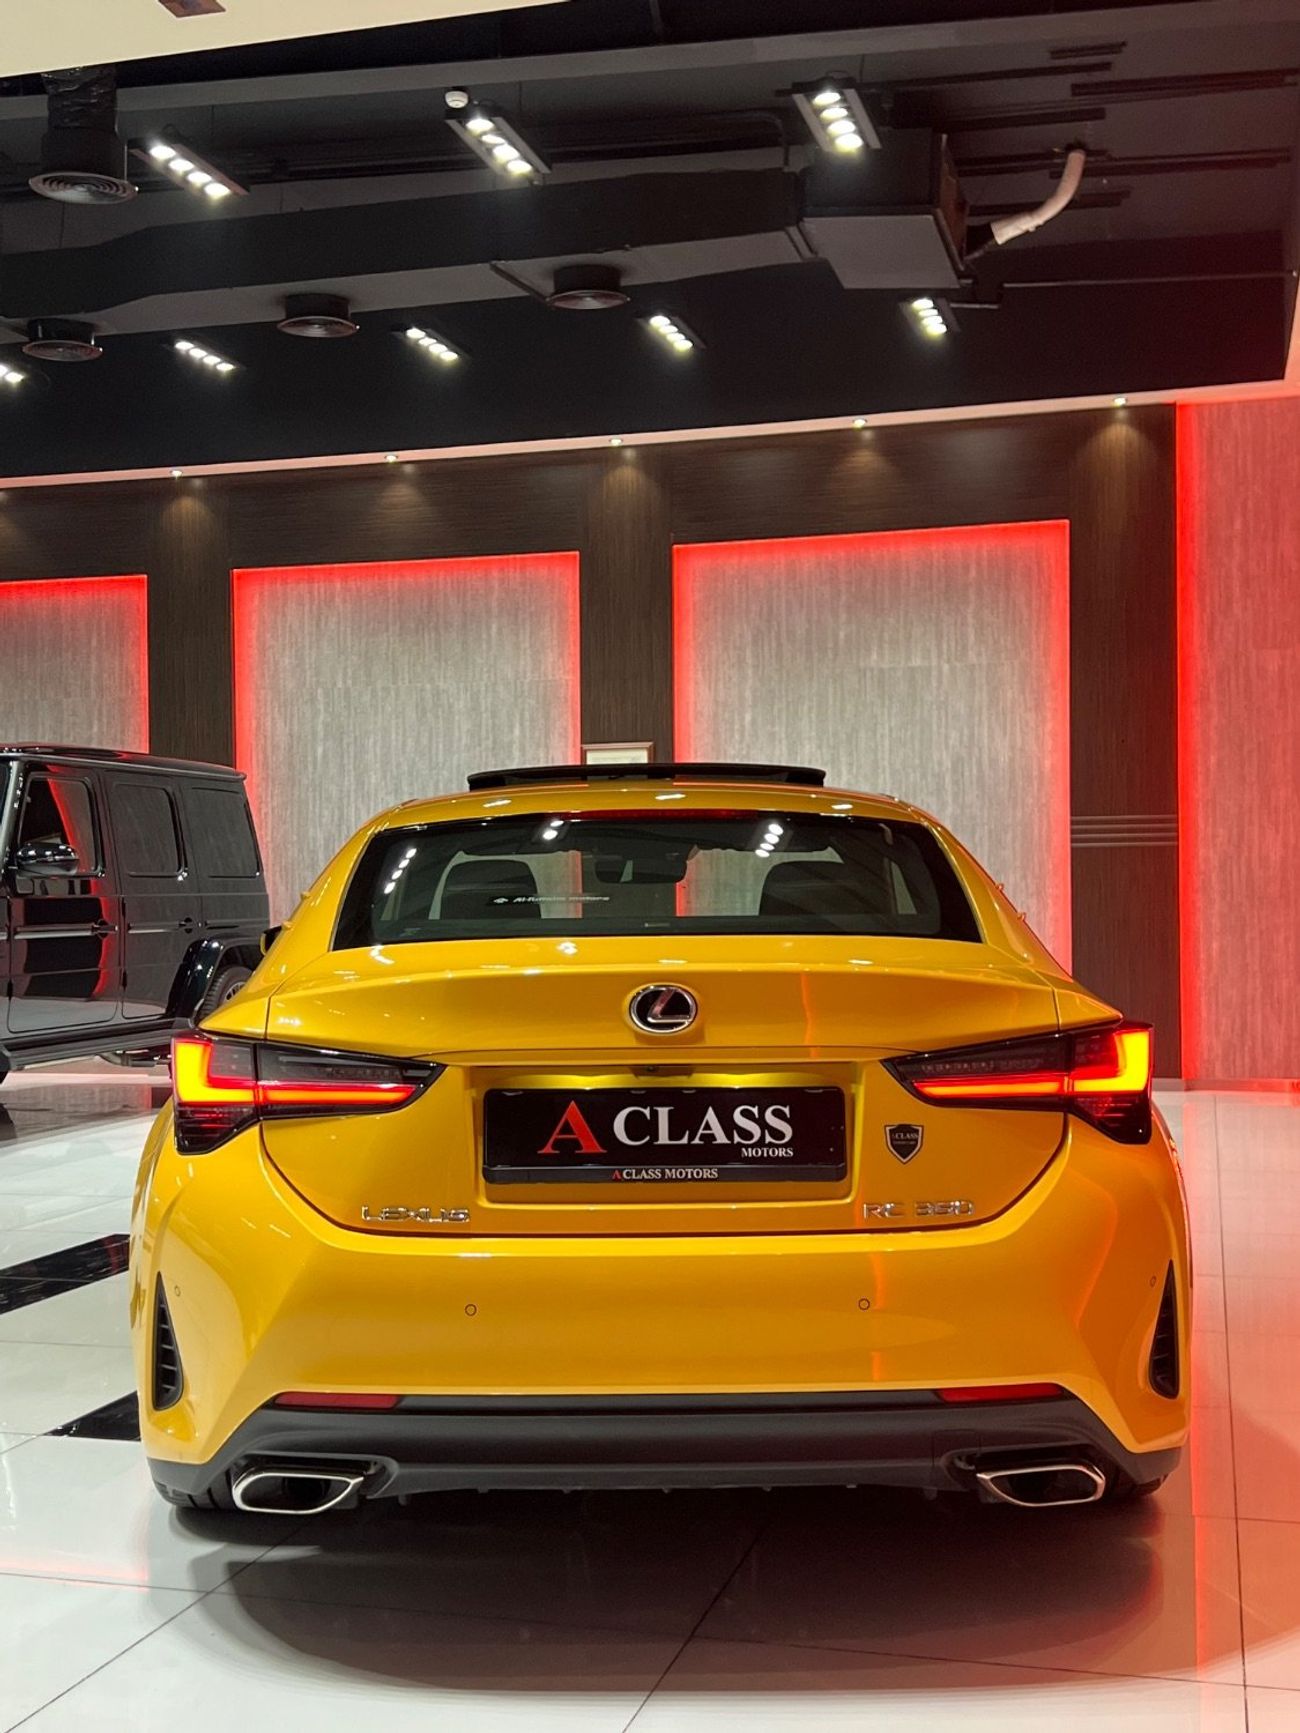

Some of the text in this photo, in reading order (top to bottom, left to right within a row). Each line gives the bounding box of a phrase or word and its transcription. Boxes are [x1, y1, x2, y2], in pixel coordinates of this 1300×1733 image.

[537, 1100, 794, 1154] A CLASS
[741, 1147, 794, 1158] MOTORS
[612, 1168, 719, 1180] A CLASS MOTORS
[361, 1205, 471, 1223] LEXUS
[863, 1202, 904, 1219] RC
